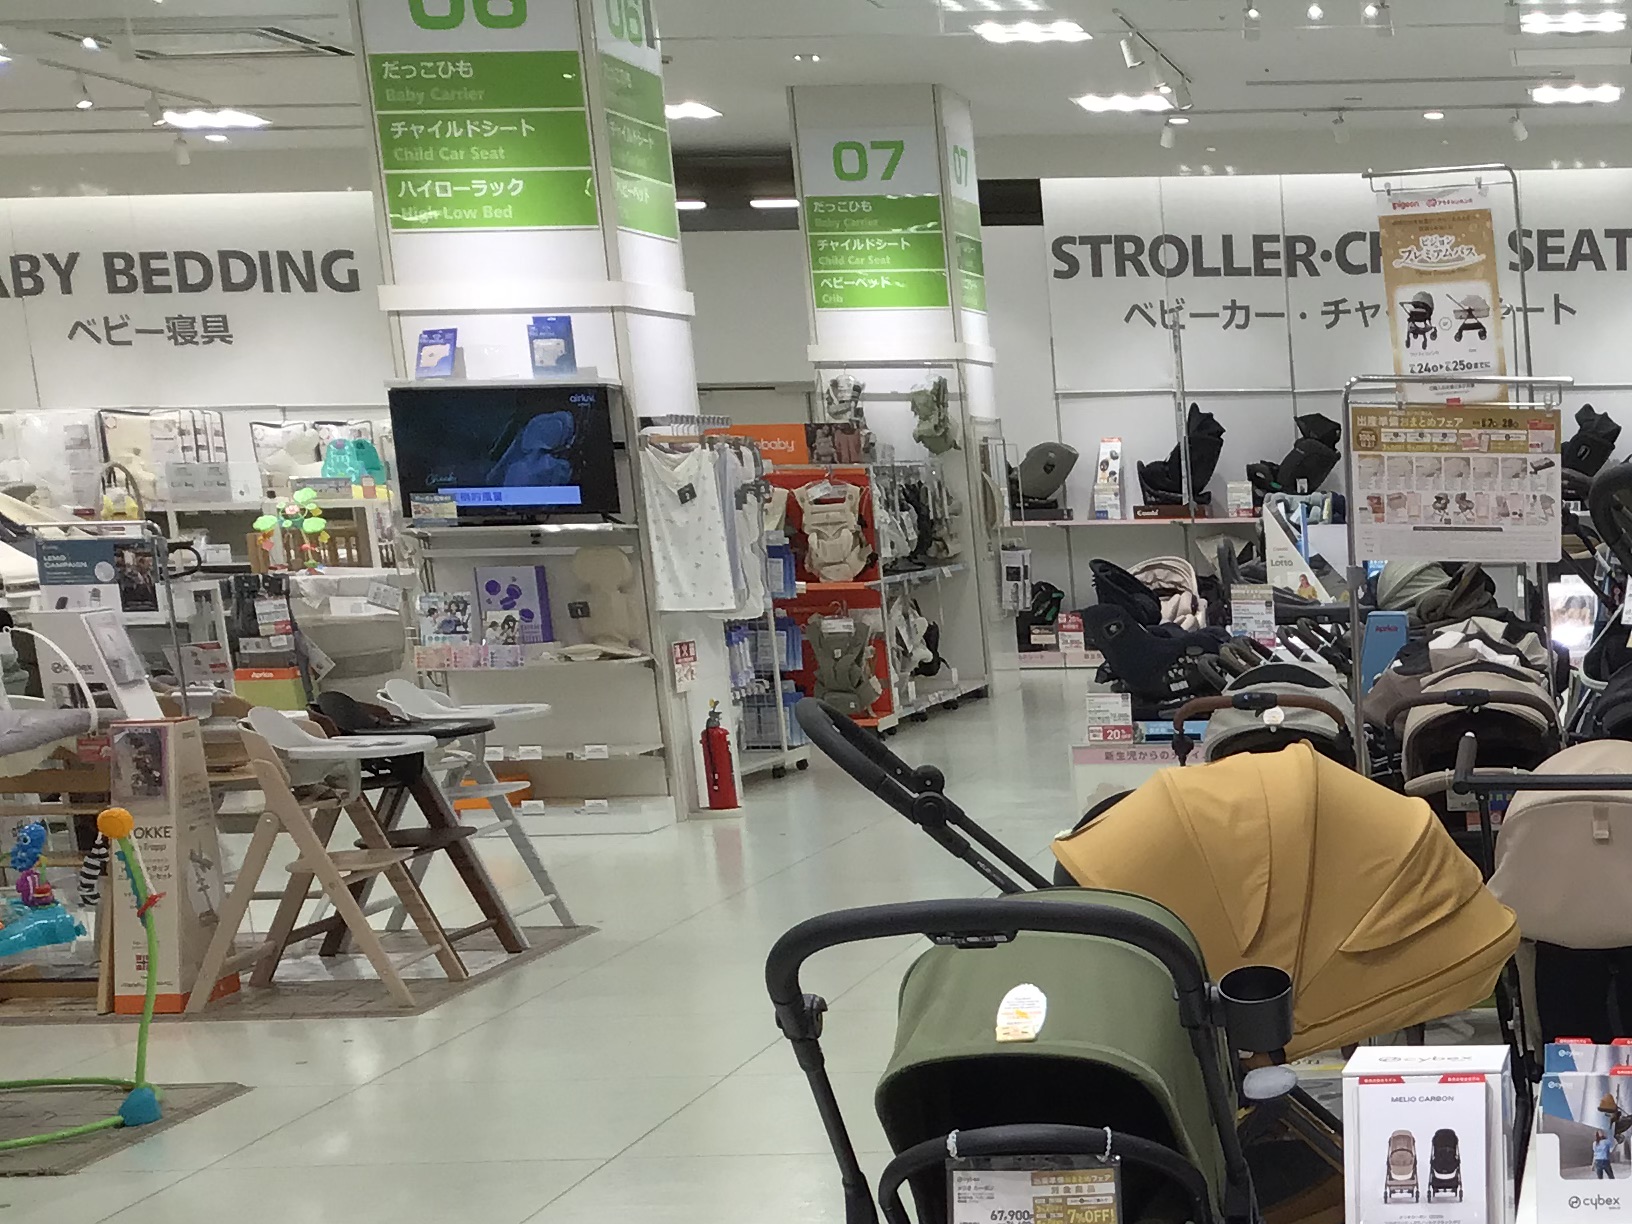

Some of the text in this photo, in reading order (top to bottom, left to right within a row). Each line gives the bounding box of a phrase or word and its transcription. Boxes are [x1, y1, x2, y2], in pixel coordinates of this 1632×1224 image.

[382, 60, 474, 79] だっこひも
[390, 118, 535, 138] チャイルドシート
[394, 147, 505, 161] Child Car Seat
[832, 140, 905, 181] 07
[398, 178, 524, 198] ハイローラック
[444, 206, 478, 219] Low
[483, 206, 513, 219] Bed
[813, 201, 873, 214] だっこひも
[817, 237, 911, 251] チャイルドシート
[103, 248, 360, 296] BEDDING
[822, 293, 844, 303] Crib
[67, 313, 235, 349] ベビー寝具
[1390, 1095, 1455, 1103] MELIO CARBON
[1582, 1194, 1621, 1210] cybex
[1066, 1207, 1116, 1224] 7%OFF!
